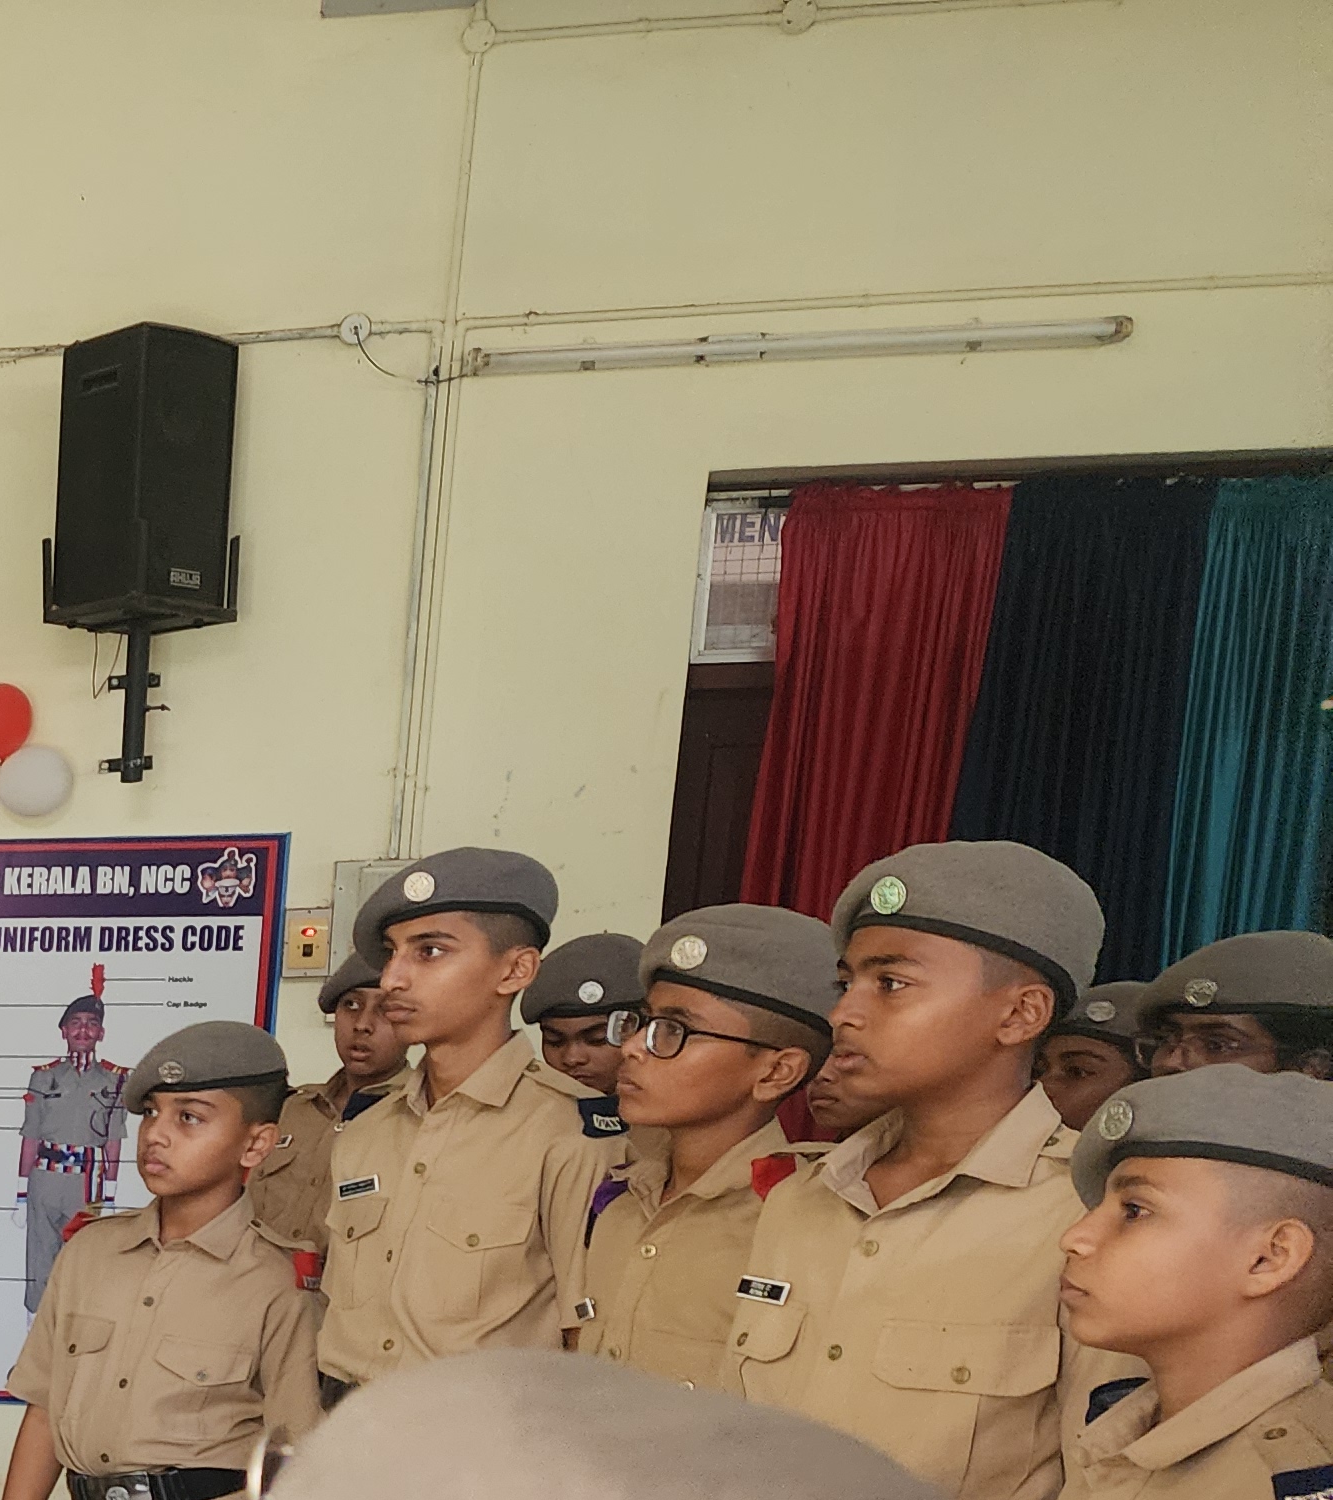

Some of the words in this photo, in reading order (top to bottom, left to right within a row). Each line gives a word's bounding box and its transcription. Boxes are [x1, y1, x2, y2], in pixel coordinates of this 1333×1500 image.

[714, 512, 786, 544] MEN
[3, 866, 92, 895] KERALA
[95, 865, 135, 897] BN,
[139, 865, 191, 894] NCC
[98, 925, 175, 952] DRESS
[180, 924, 245, 952] CODE
[166, 1000, 182, 1009] Cap
